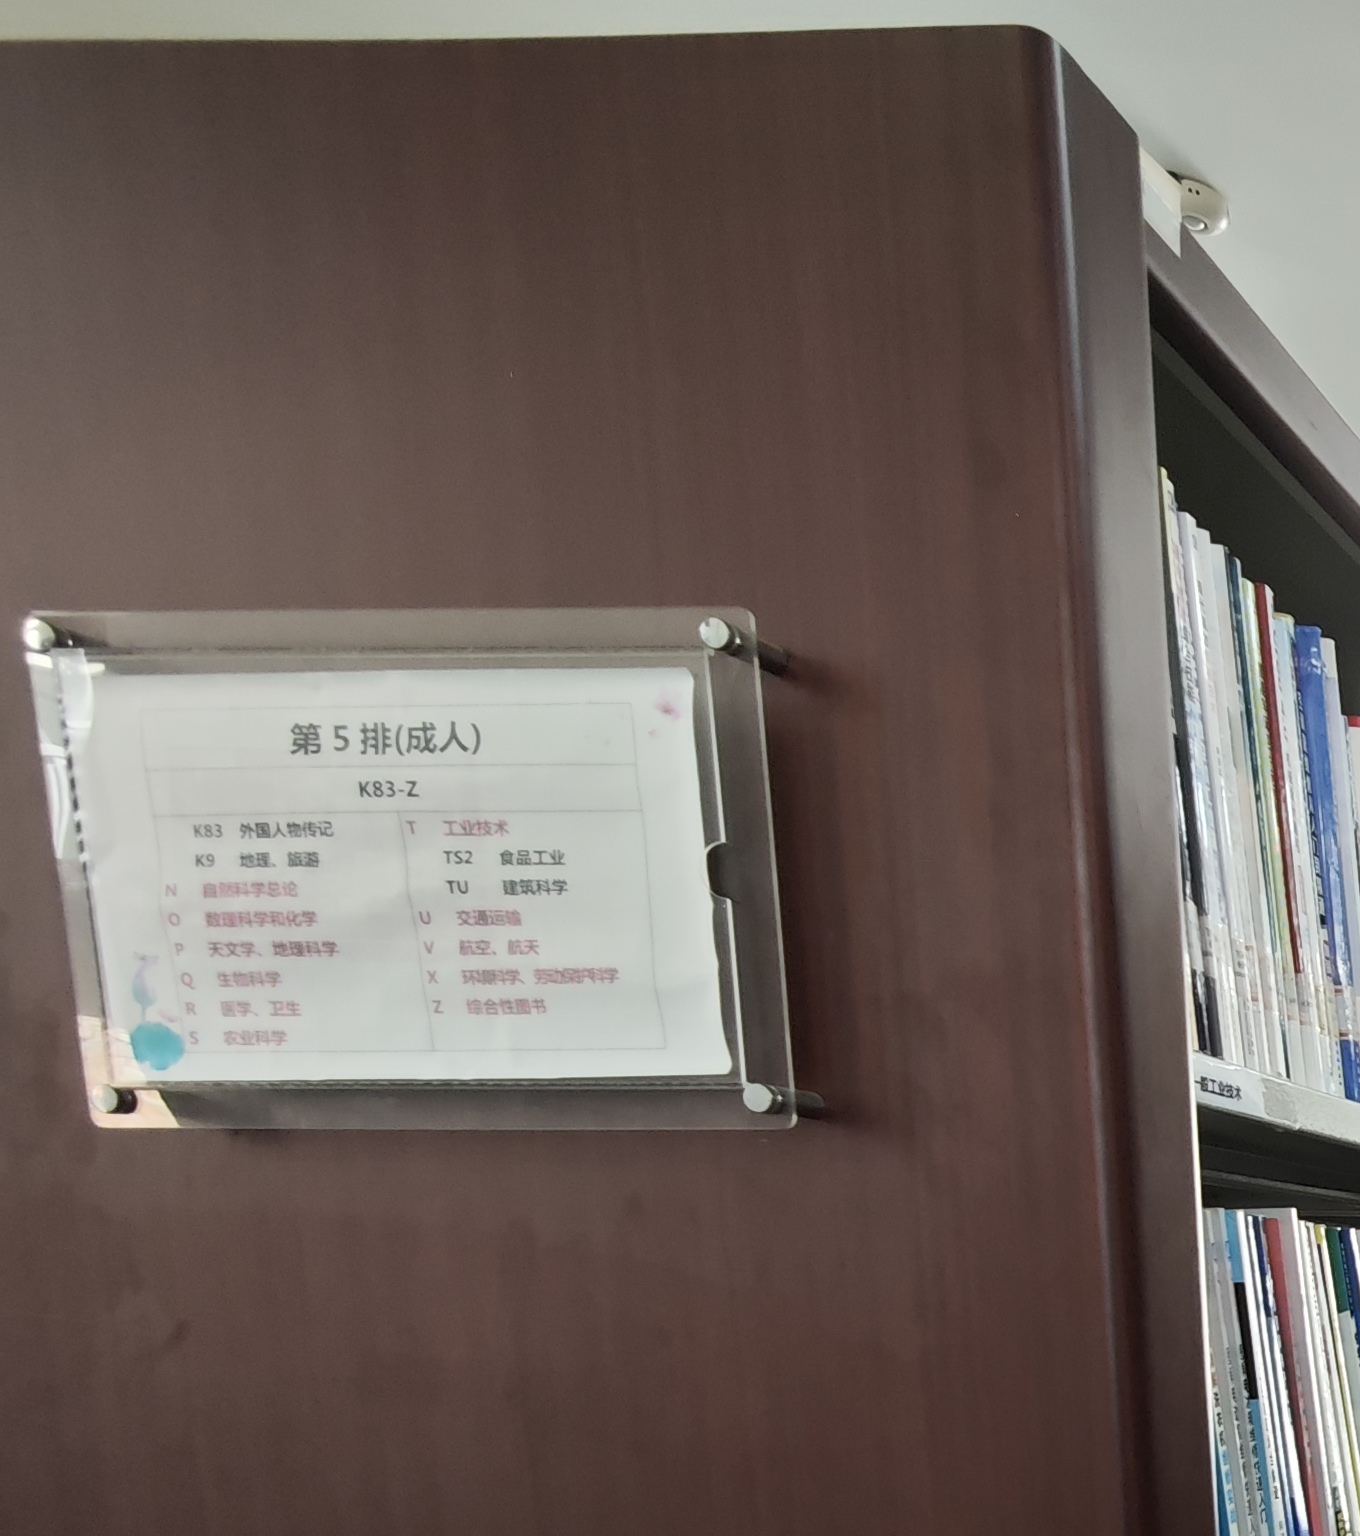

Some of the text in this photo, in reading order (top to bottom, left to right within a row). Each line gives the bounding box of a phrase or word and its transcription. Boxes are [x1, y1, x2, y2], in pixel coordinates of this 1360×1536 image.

[290, 723, 321, 755] 第
[334, 725, 349, 751] 5
[359, 781, 419, 797] K83-Z
[193, 821, 334, 838] K83 外国人物传记
[405, 820, 509, 836] T 工业技术
[195, 851, 320, 868] K9 地理、旅游
[443, 850, 565, 865] TS2 食品工业
[165, 881, 298, 898] N 自然科学总论
[446, 879, 567, 895] TU 建筑科学
[205, 911, 317, 928] 数理科学和化学
[419, 910, 521, 926] U 交通运输
[174, 941, 339, 957] P 天文学、地理科学
[424, 940, 539, 956] V 航空、航天
[180, 971, 282, 990] Q 生物科学
[426, 971, 438, 984] X
[184, 1000, 301, 1017] R 医学、卫生
[432, 998, 546, 1015] Z 综合性图书
[189, 1030, 288, 1046] S 农业科学
